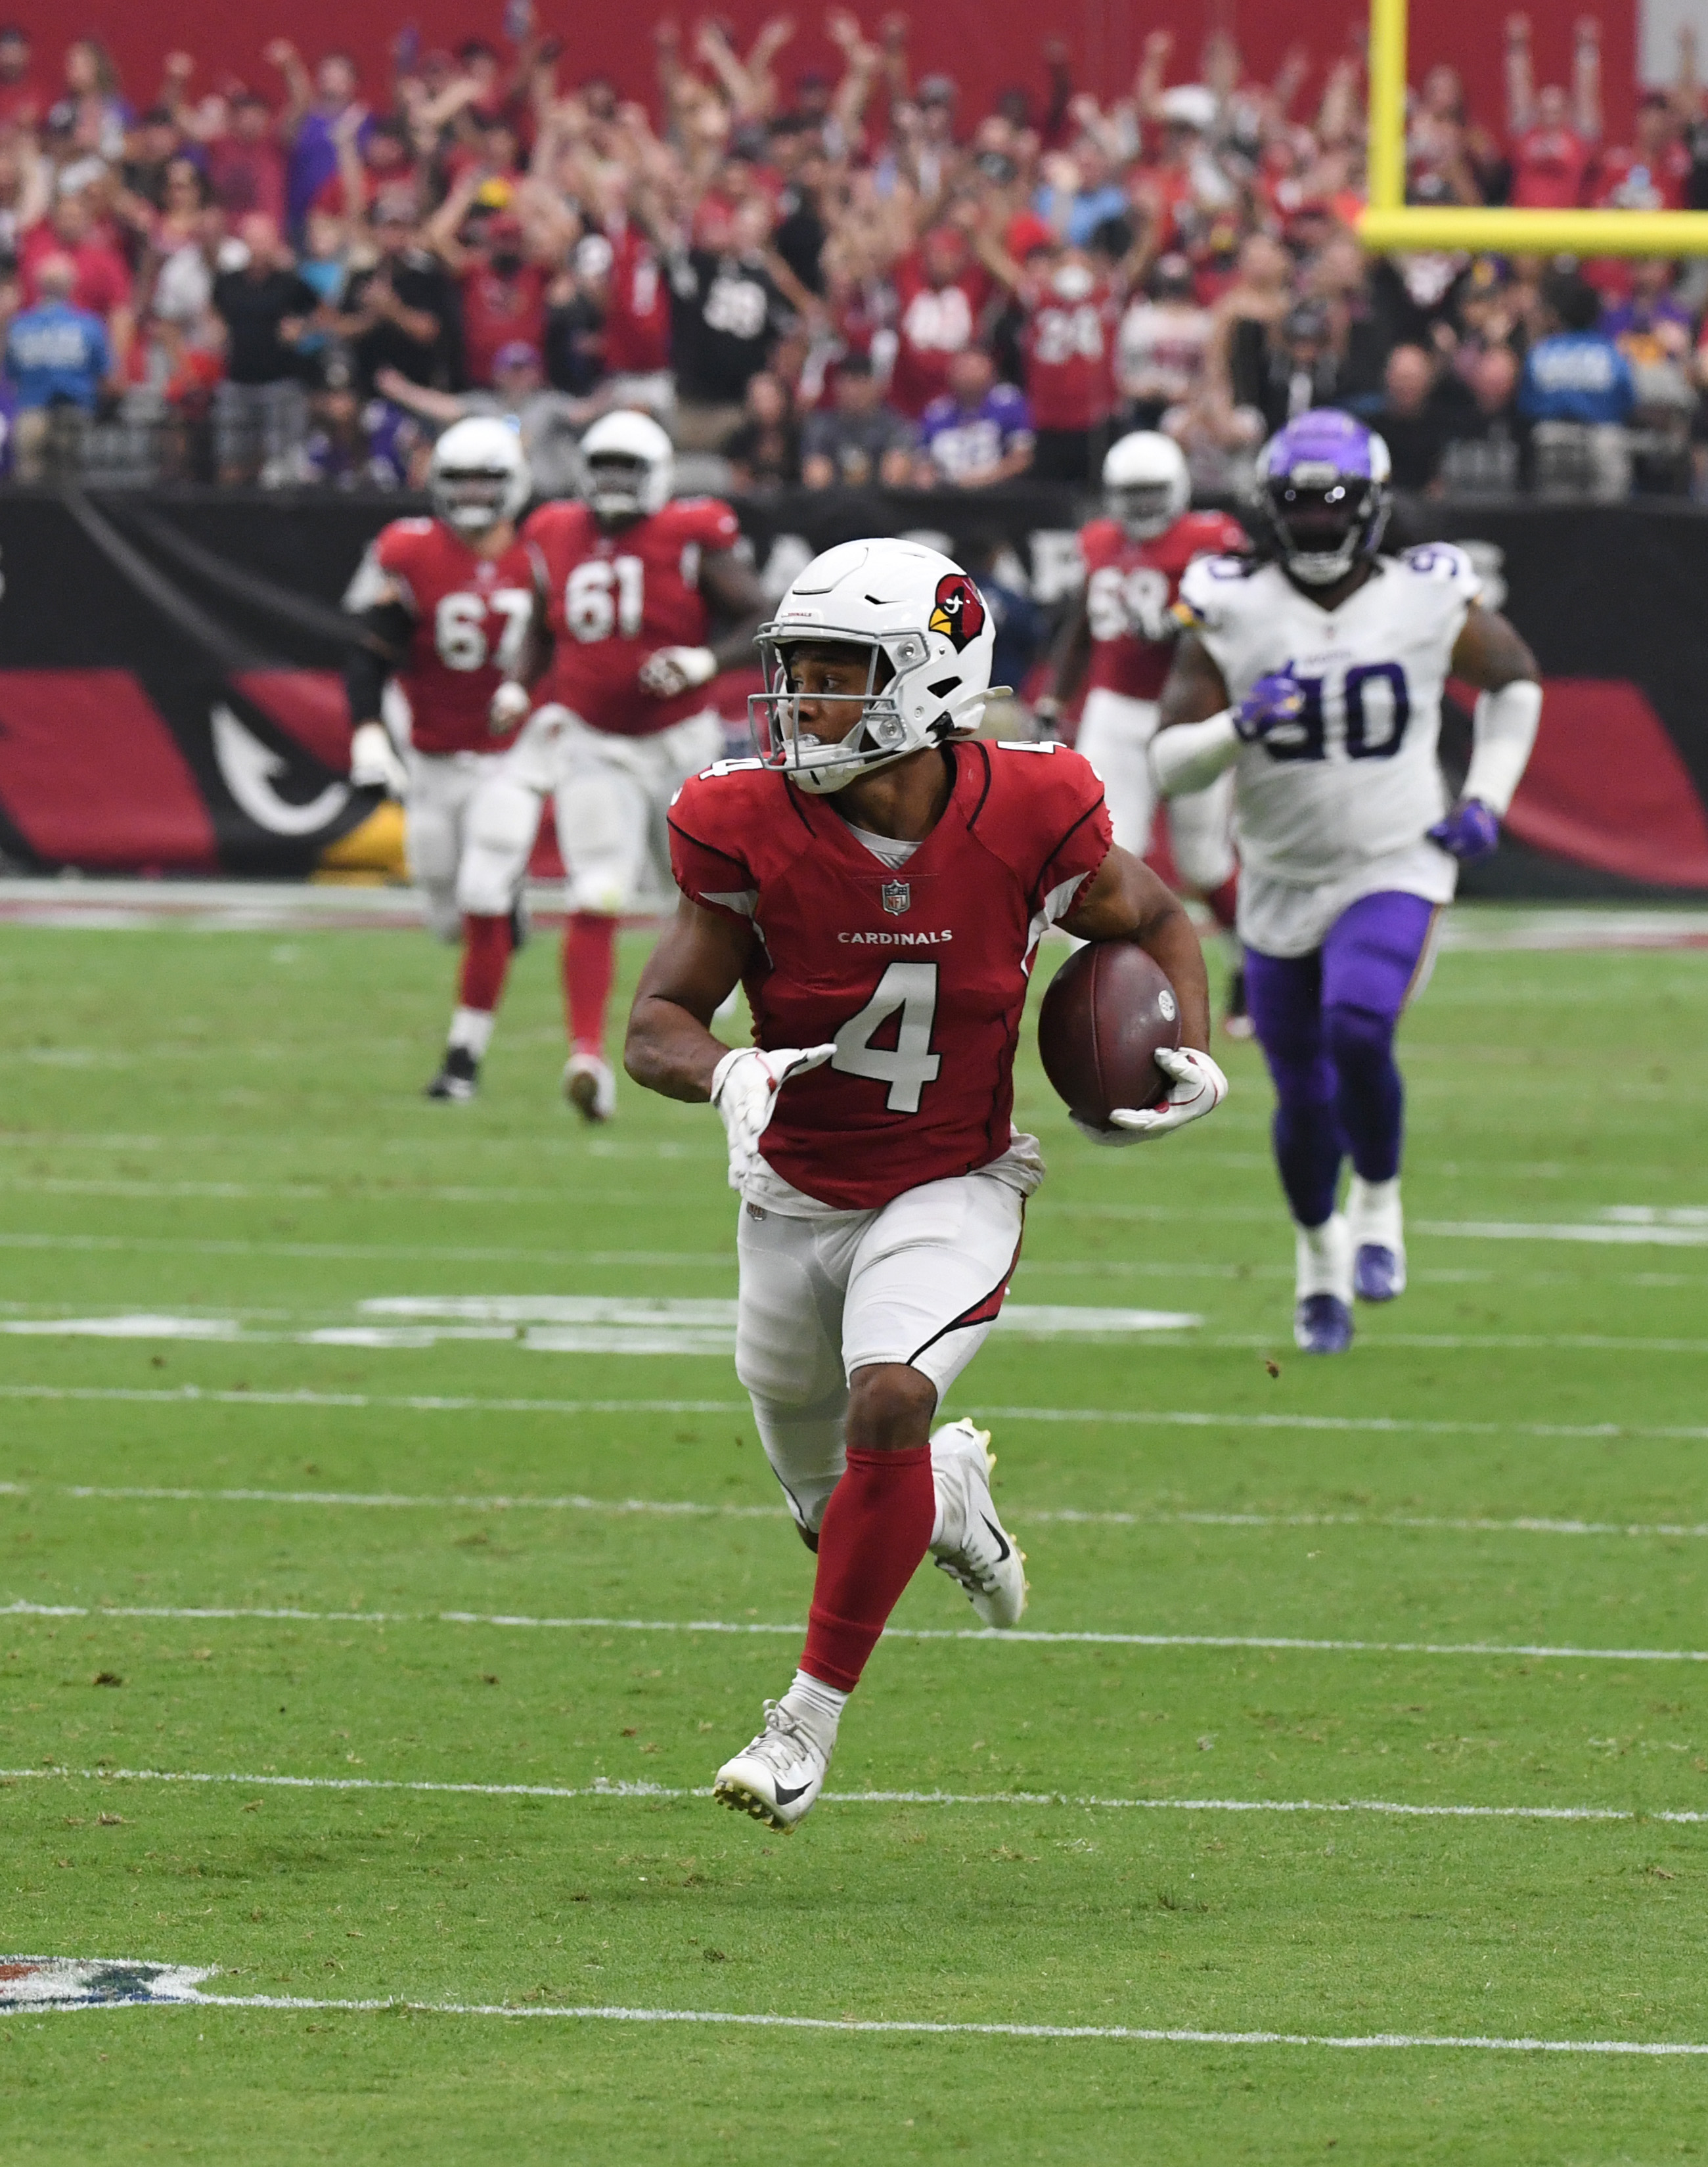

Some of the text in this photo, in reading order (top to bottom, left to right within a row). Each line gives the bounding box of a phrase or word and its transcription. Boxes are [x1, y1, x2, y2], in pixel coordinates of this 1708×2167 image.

[436, 587, 533, 672] 67
[566, 555, 644, 643] 61
[837, 929, 953, 945] CARDINALS
[831, 962, 941, 1113] 4
